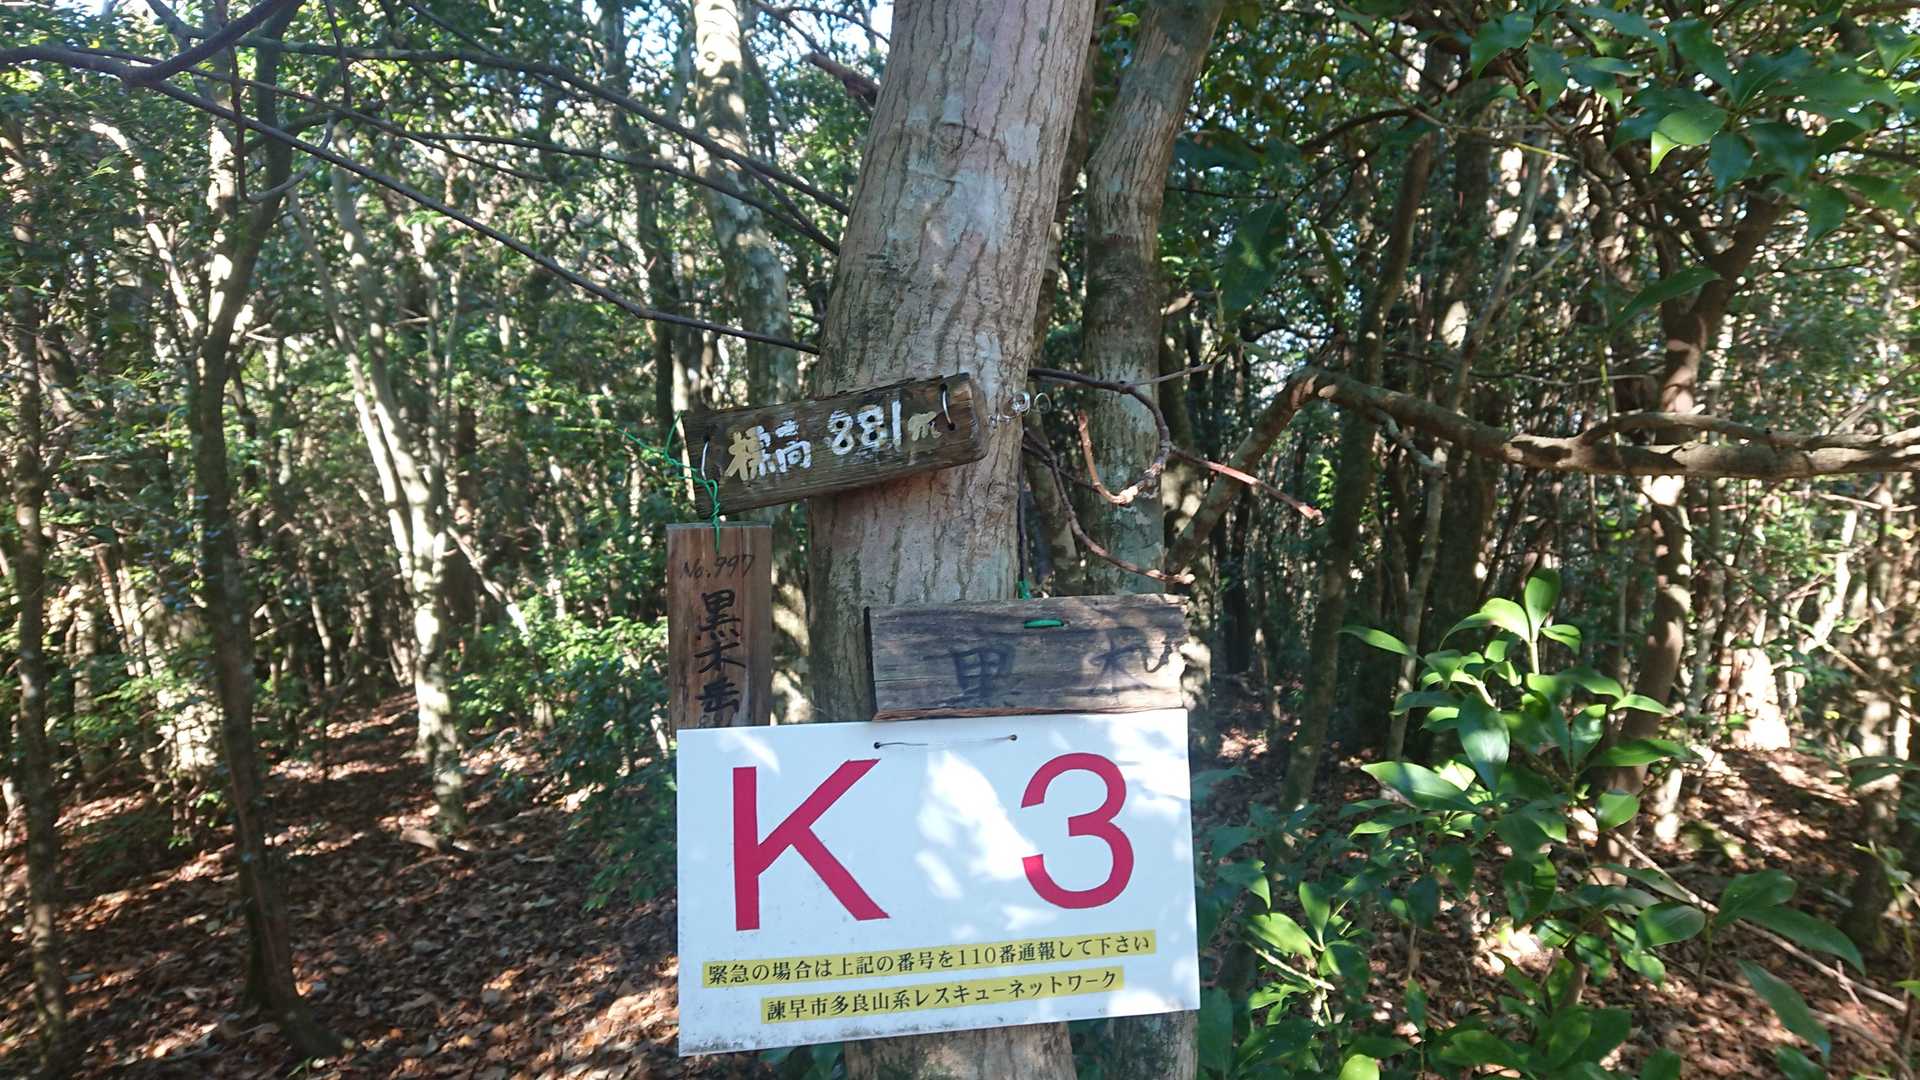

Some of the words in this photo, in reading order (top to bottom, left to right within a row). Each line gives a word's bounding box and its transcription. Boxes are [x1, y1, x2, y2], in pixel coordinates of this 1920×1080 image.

[733, 758, 890, 932] K
[1021, 752, 1134, 909] 3
[708, 936, 1151, 985] 緊急の場合は上記の番号を110番通報して下さい
[767, 970, 1118, 1021] 諫早市多良山系レスキューネットワーク
